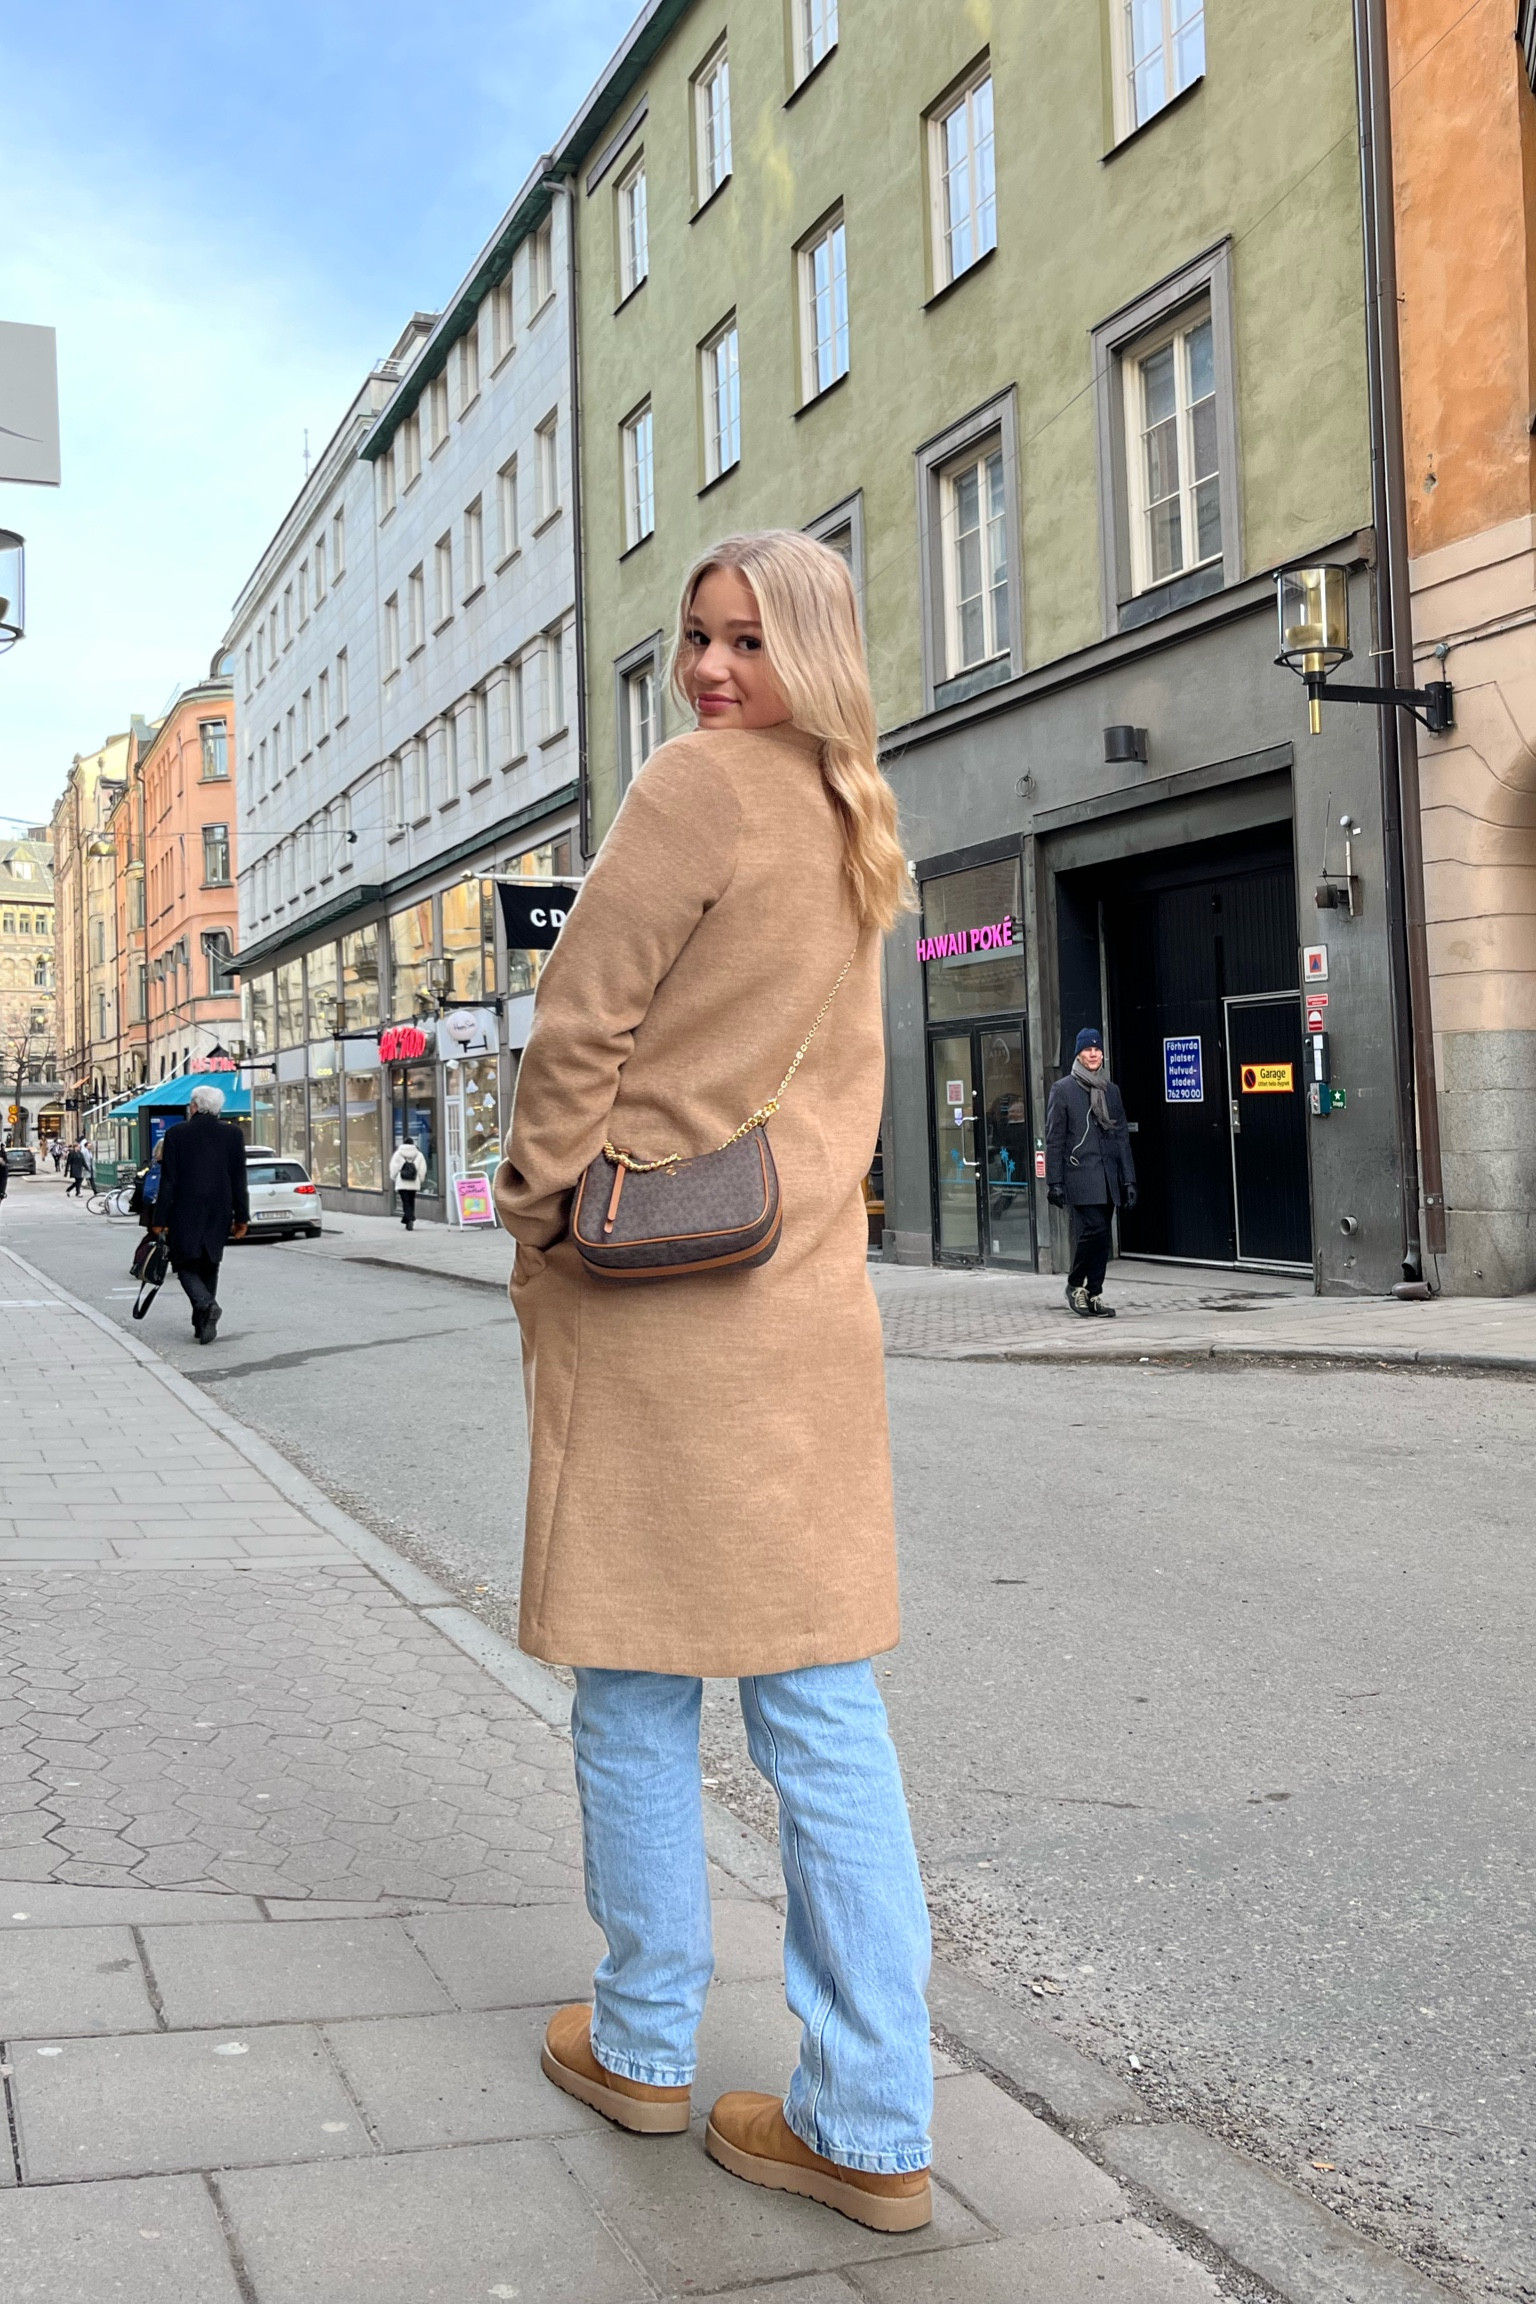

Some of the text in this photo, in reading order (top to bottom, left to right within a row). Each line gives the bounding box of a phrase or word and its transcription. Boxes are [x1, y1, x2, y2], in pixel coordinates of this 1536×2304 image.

[916, 915, 1012, 962] HAWAII POKÉ
[1166, 1041, 1198, 1052] Förhyrda
[1170, 1054, 1195, 1064] platser
[1260, 1068, 1286, 1081] Garage
[1172, 1078, 1196, 1087] staden
[1168, 1089, 1200, 1099] 762 90 00
